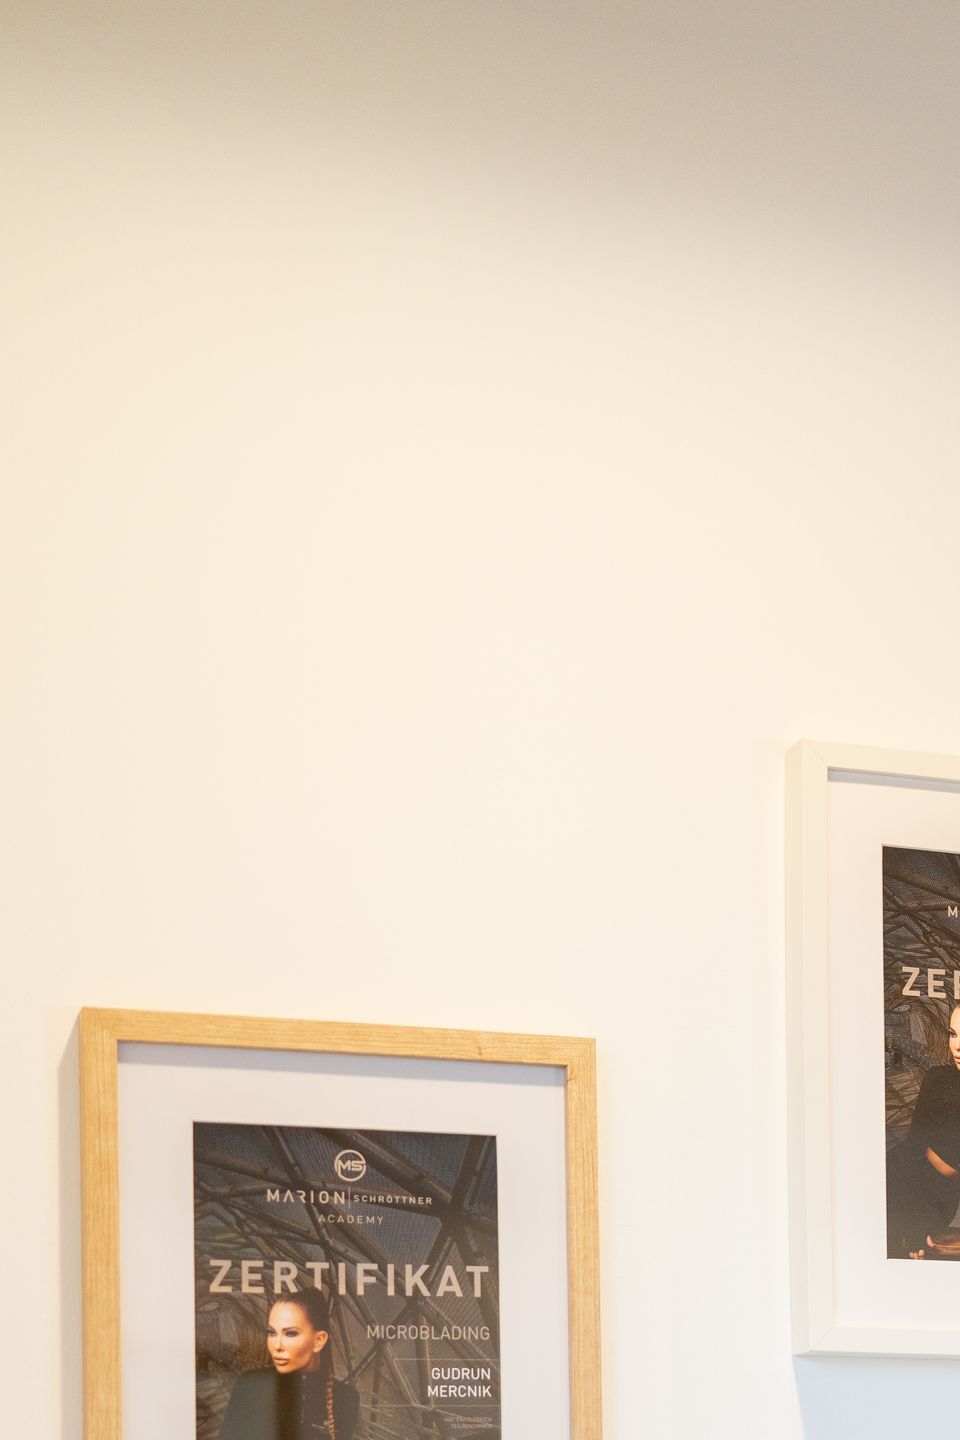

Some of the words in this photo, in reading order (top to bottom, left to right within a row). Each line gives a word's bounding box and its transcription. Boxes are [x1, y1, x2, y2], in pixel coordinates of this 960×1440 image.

[267, 1189, 345, 1204] MARION
[318, 1214, 384, 1225] ACADEMY
[209, 1259, 489, 1297] ZERTIFIKAT
[367, 1325, 490, 1340] MICROBLADING
[431, 1368, 491, 1380] GUDRUN
[427, 1385, 492, 1397] MERCNIK
